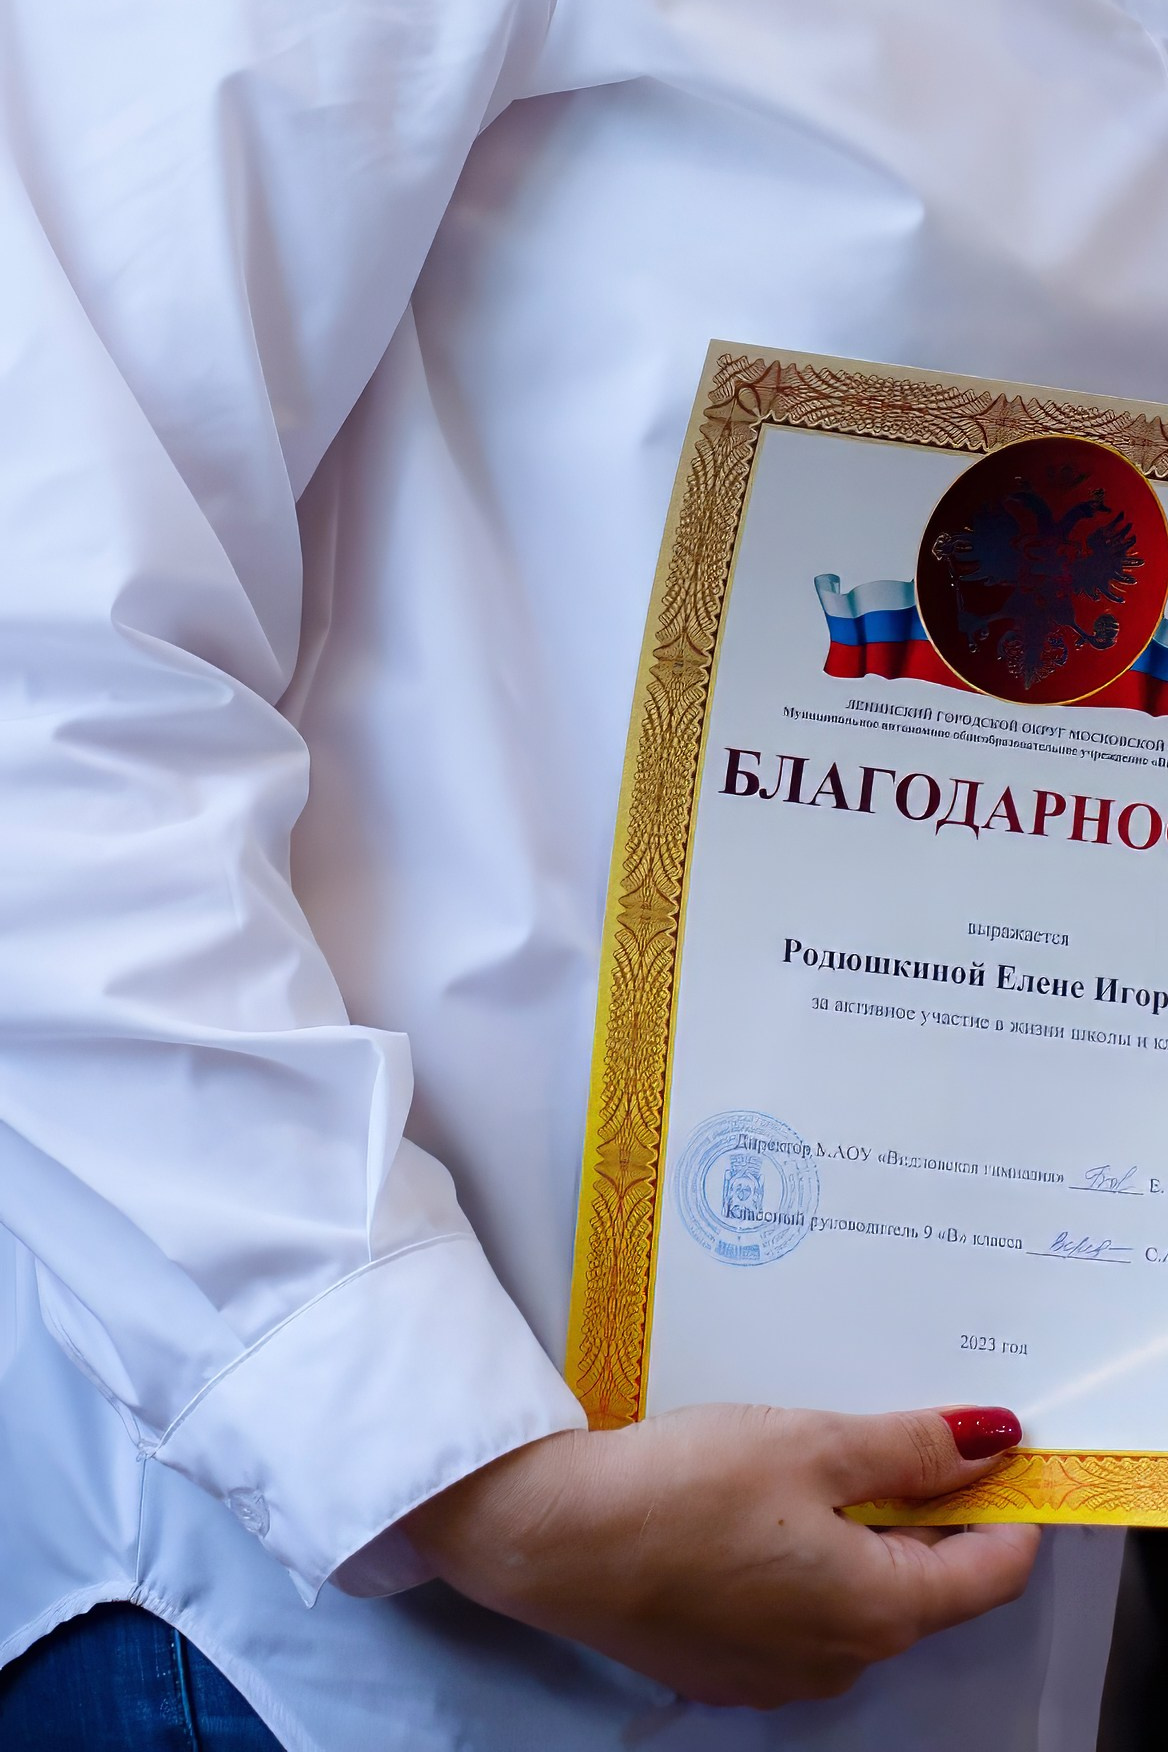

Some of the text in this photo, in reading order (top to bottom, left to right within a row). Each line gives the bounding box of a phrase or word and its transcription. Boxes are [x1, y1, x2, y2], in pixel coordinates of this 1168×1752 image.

[845, 699, 933, 720] ЛЕНИНСКИЙ
[936, 711, 1018, 732] ГОРОДСКОЙ
[1021, 723, 1066, 739] ОКРУГ
[1070, 730, 1165, 752] МОСКОВСКОЙ
[967, 920, 1070, 947] выражается
[782, 937, 986, 990] Родюшкиной
[995, 963, 1086, 1000] Елене
[811, 996, 830, 1012] за
[834, 1000, 917, 1022] активное
[920, 1010, 991, 1031] участие
[994, 1019, 1006, 1032] в
[1009, 1022, 1066, 1041] жизни
[1070, 1027, 1133, 1048] школы
[1137, 1034, 1150, 1048] и
[1149, 1178, 1165, 1195] Е.
[809, 1215, 920, 1239] руководитель
[923, 1225, 933, 1240] 9
[937, 1227, 967, 1245] «В»
[972, 1234, 1024, 1250] класса
[959, 1333, 1029, 1357] 2023 год
